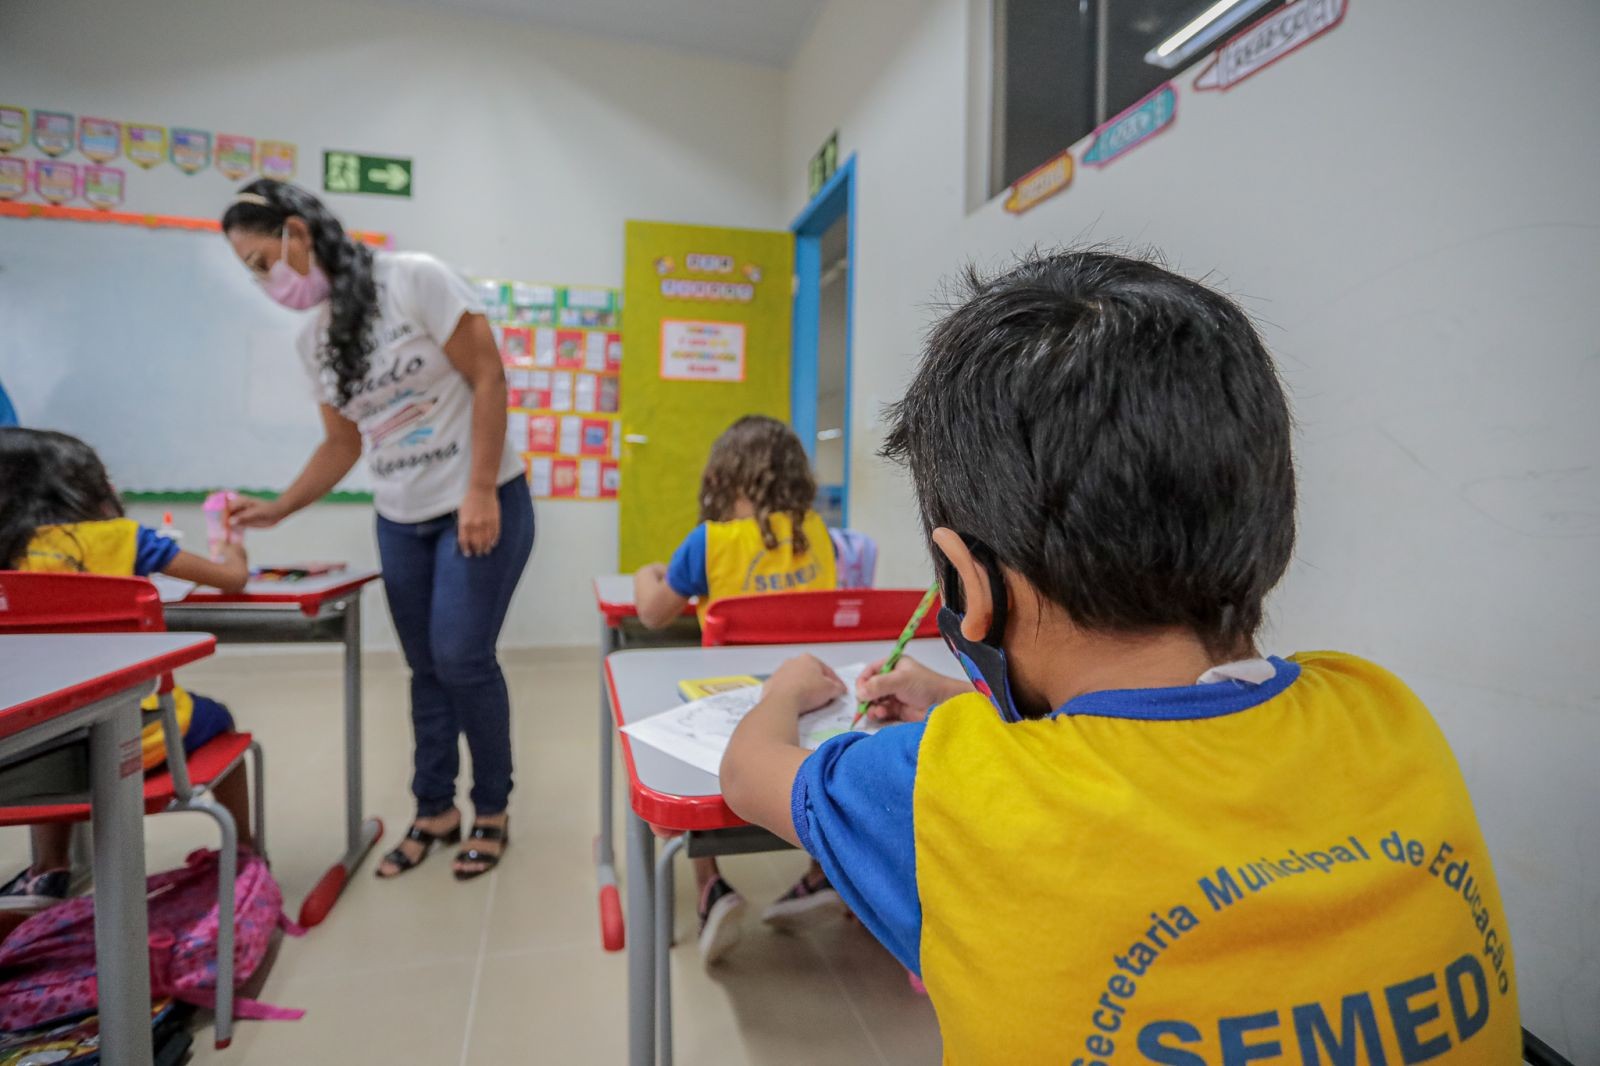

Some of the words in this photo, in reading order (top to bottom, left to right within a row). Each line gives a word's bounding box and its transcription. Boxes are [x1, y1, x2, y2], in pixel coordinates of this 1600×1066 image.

[1197, 835, 1370, 912] Municipal
[1380, 830, 1425, 867] de
[1428, 841, 1509, 995] Educação
[1136, 953, 1490, 1066] SEMED
